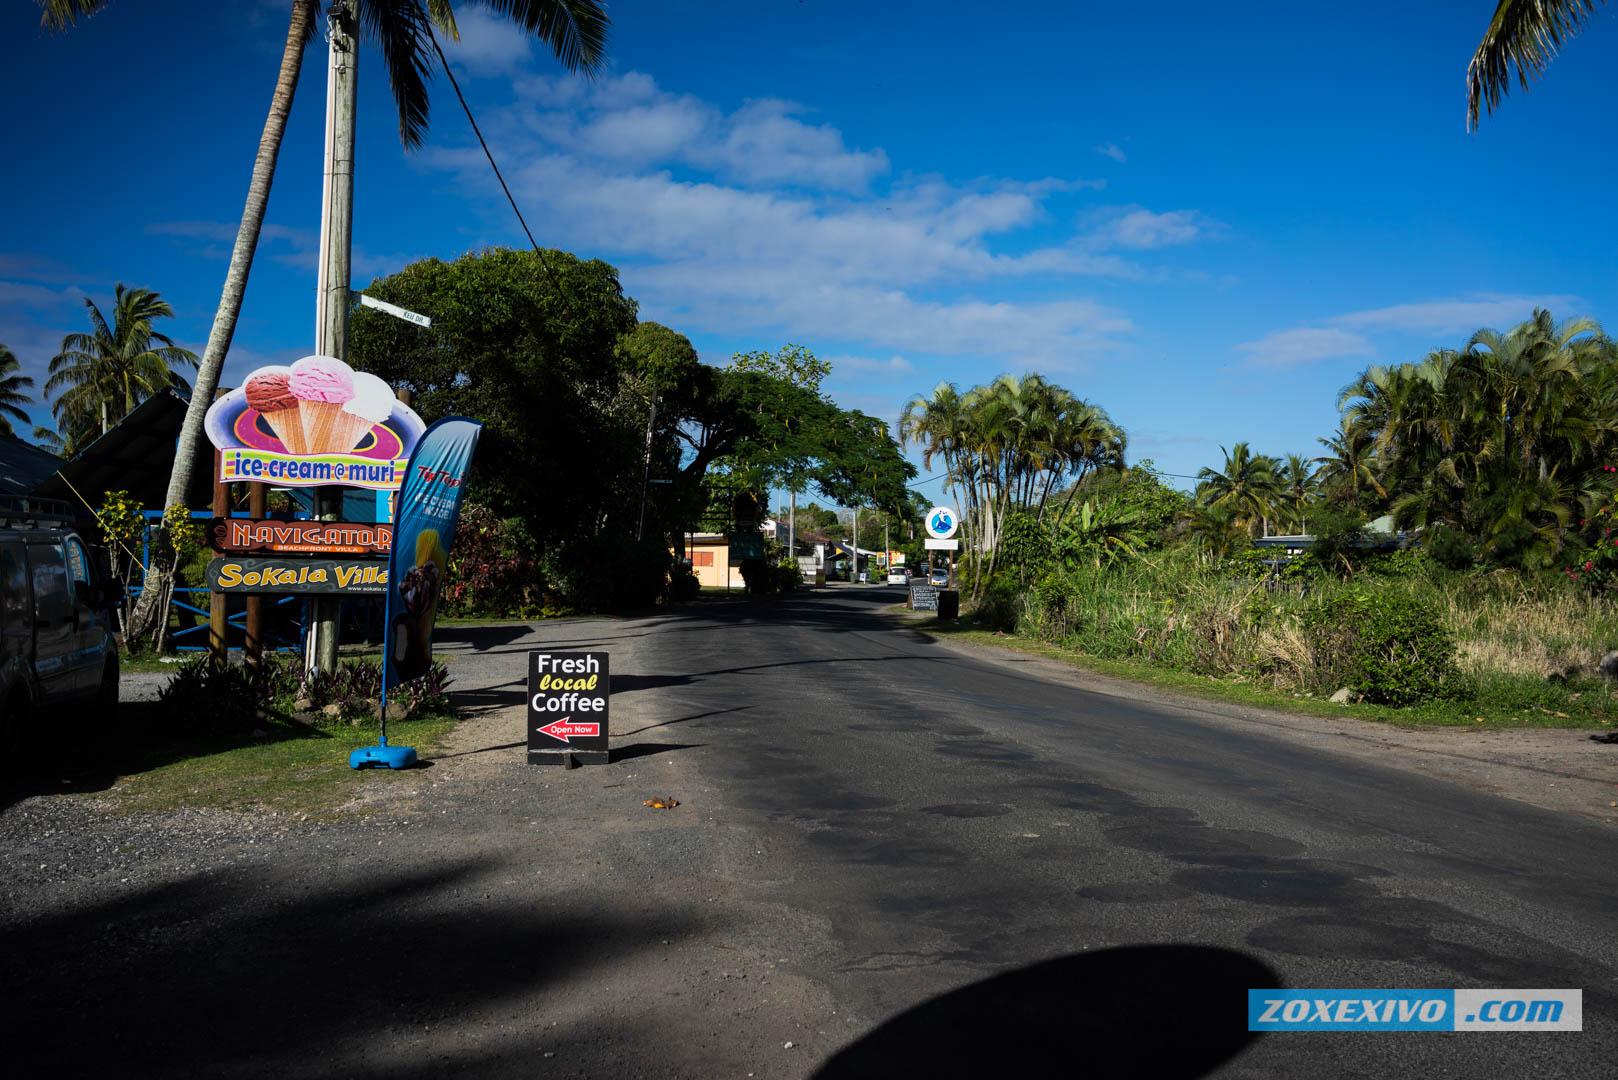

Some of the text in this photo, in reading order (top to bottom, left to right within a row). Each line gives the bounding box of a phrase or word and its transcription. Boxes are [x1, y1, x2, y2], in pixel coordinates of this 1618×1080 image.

[538, 654, 599, 673] Fresh
[539, 674, 598, 691] local
[531, 692, 605, 712] Coffee
[550, 725, 592, 735] Open Now
